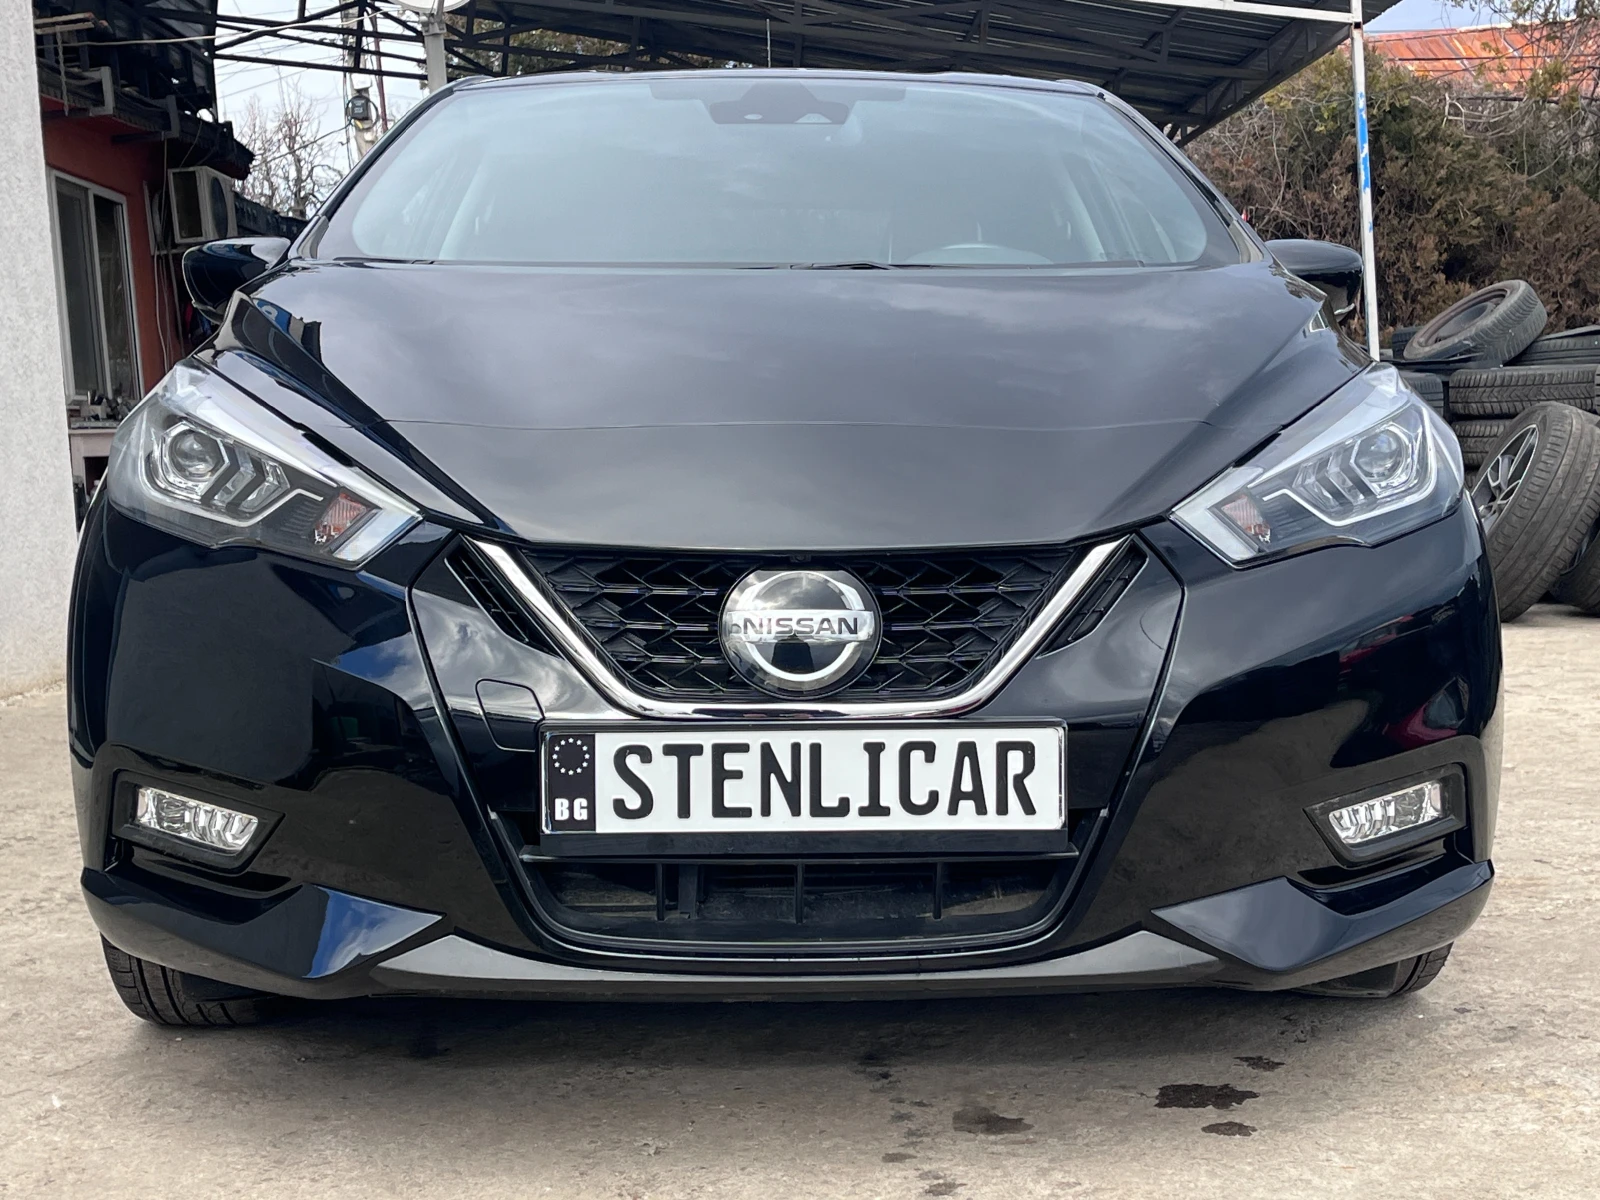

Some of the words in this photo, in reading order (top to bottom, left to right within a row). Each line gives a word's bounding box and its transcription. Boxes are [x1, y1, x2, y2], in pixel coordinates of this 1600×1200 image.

[743, 617, 858, 635] NISSAN
[613, 741, 1037, 819] STENLICAR
[554, 797, 588, 821] BG
